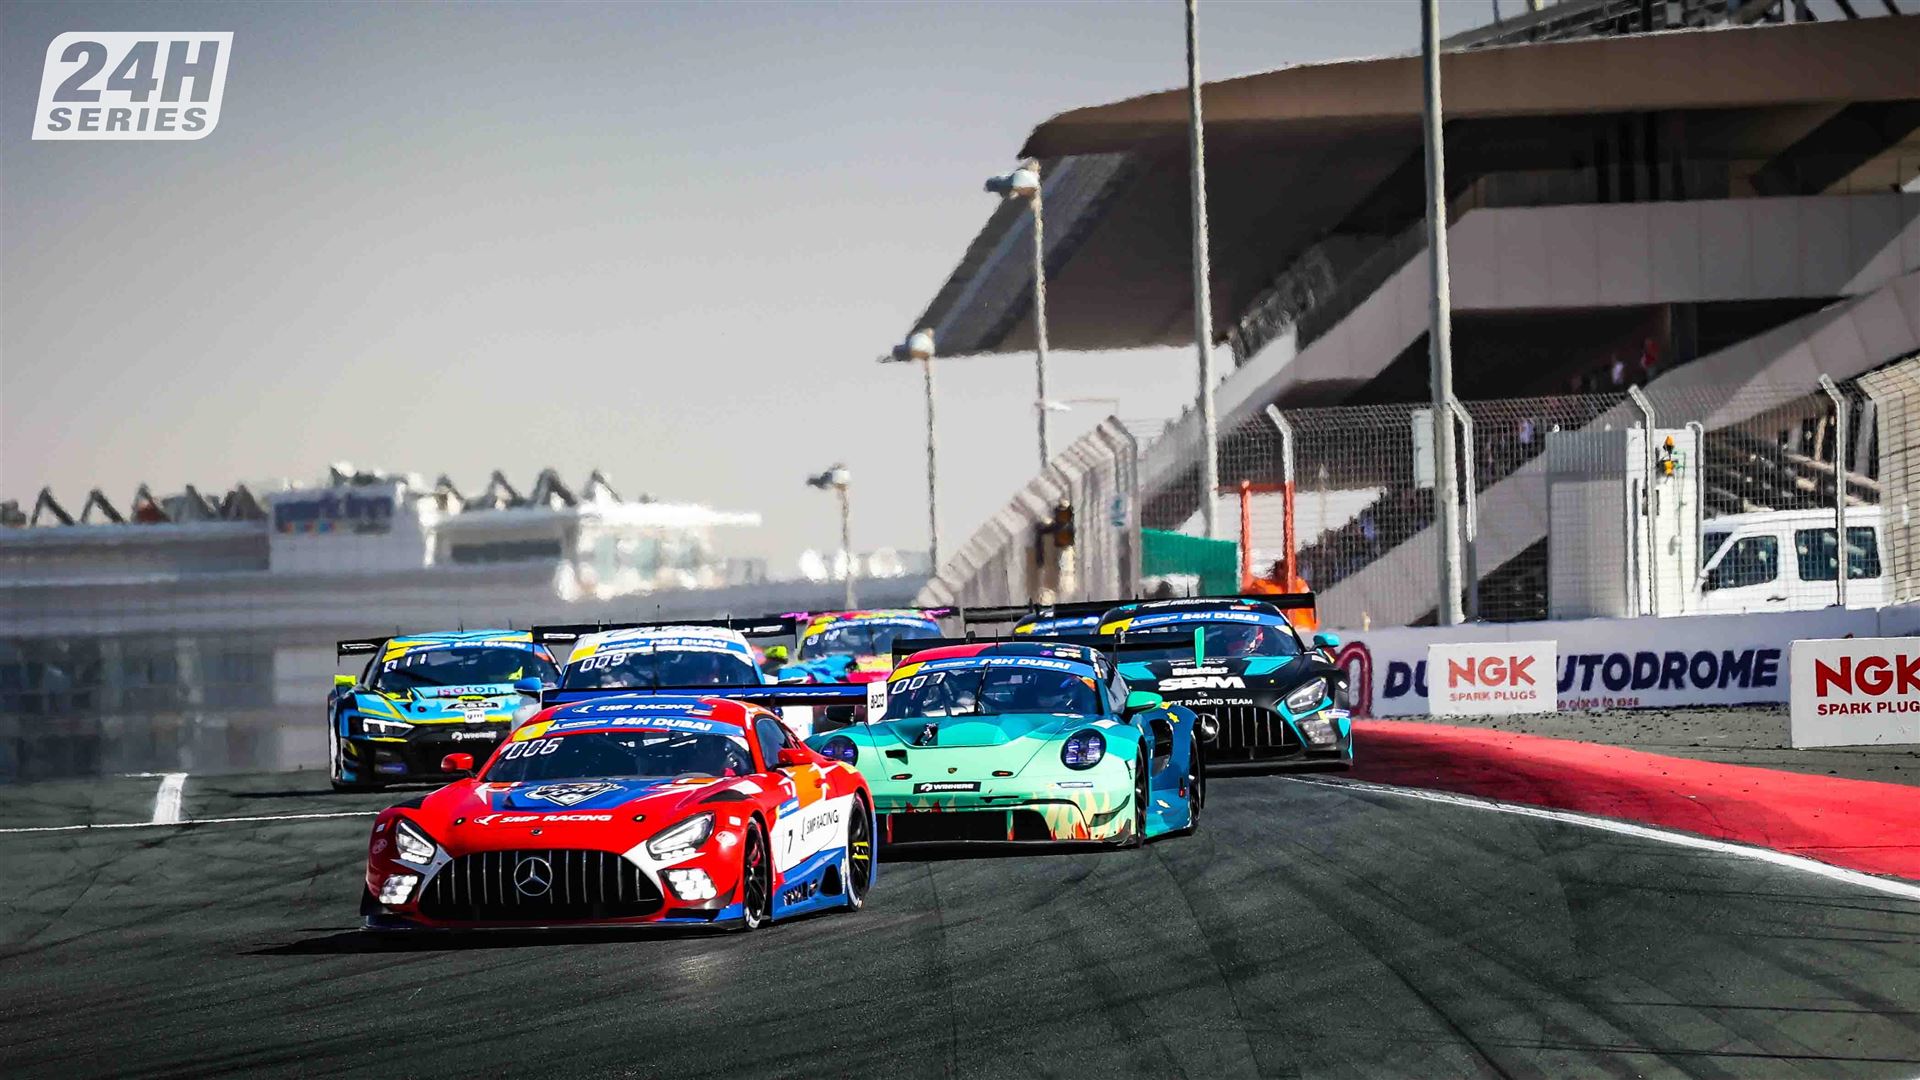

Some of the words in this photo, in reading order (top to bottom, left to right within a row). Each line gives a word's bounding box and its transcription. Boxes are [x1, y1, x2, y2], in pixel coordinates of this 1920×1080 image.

[1214, 612, 1260, 621] DUBAI
[579, 653, 627, 673] 009
[979, 658, 1014, 666] 24H
[1017, 658, 1073, 670] DUBAI
[1448, 655, 1537, 688] NGK
[1557, 648, 1782, 694] UTODROME
[891, 672, 946, 695] 007
[1815, 655, 1920, 697] NGK
[1185, 698, 1225, 706] RACING
[1450, 691, 1491, 702] SPARK
[1494, 690, 1537, 700] PLUGS
[633, 703, 695, 711] RACING
[1817, 702, 1872, 716] SPARK
[612, 717, 650, 726] 24H
[652, 717, 713, 731] DUBAI
[505, 737, 564, 760] 006
[500, 815, 540, 824] SMP
[542, 814, 613, 822] RACING
[816, 809, 839, 829] RACING
[788, 829, 794, 854] 7
